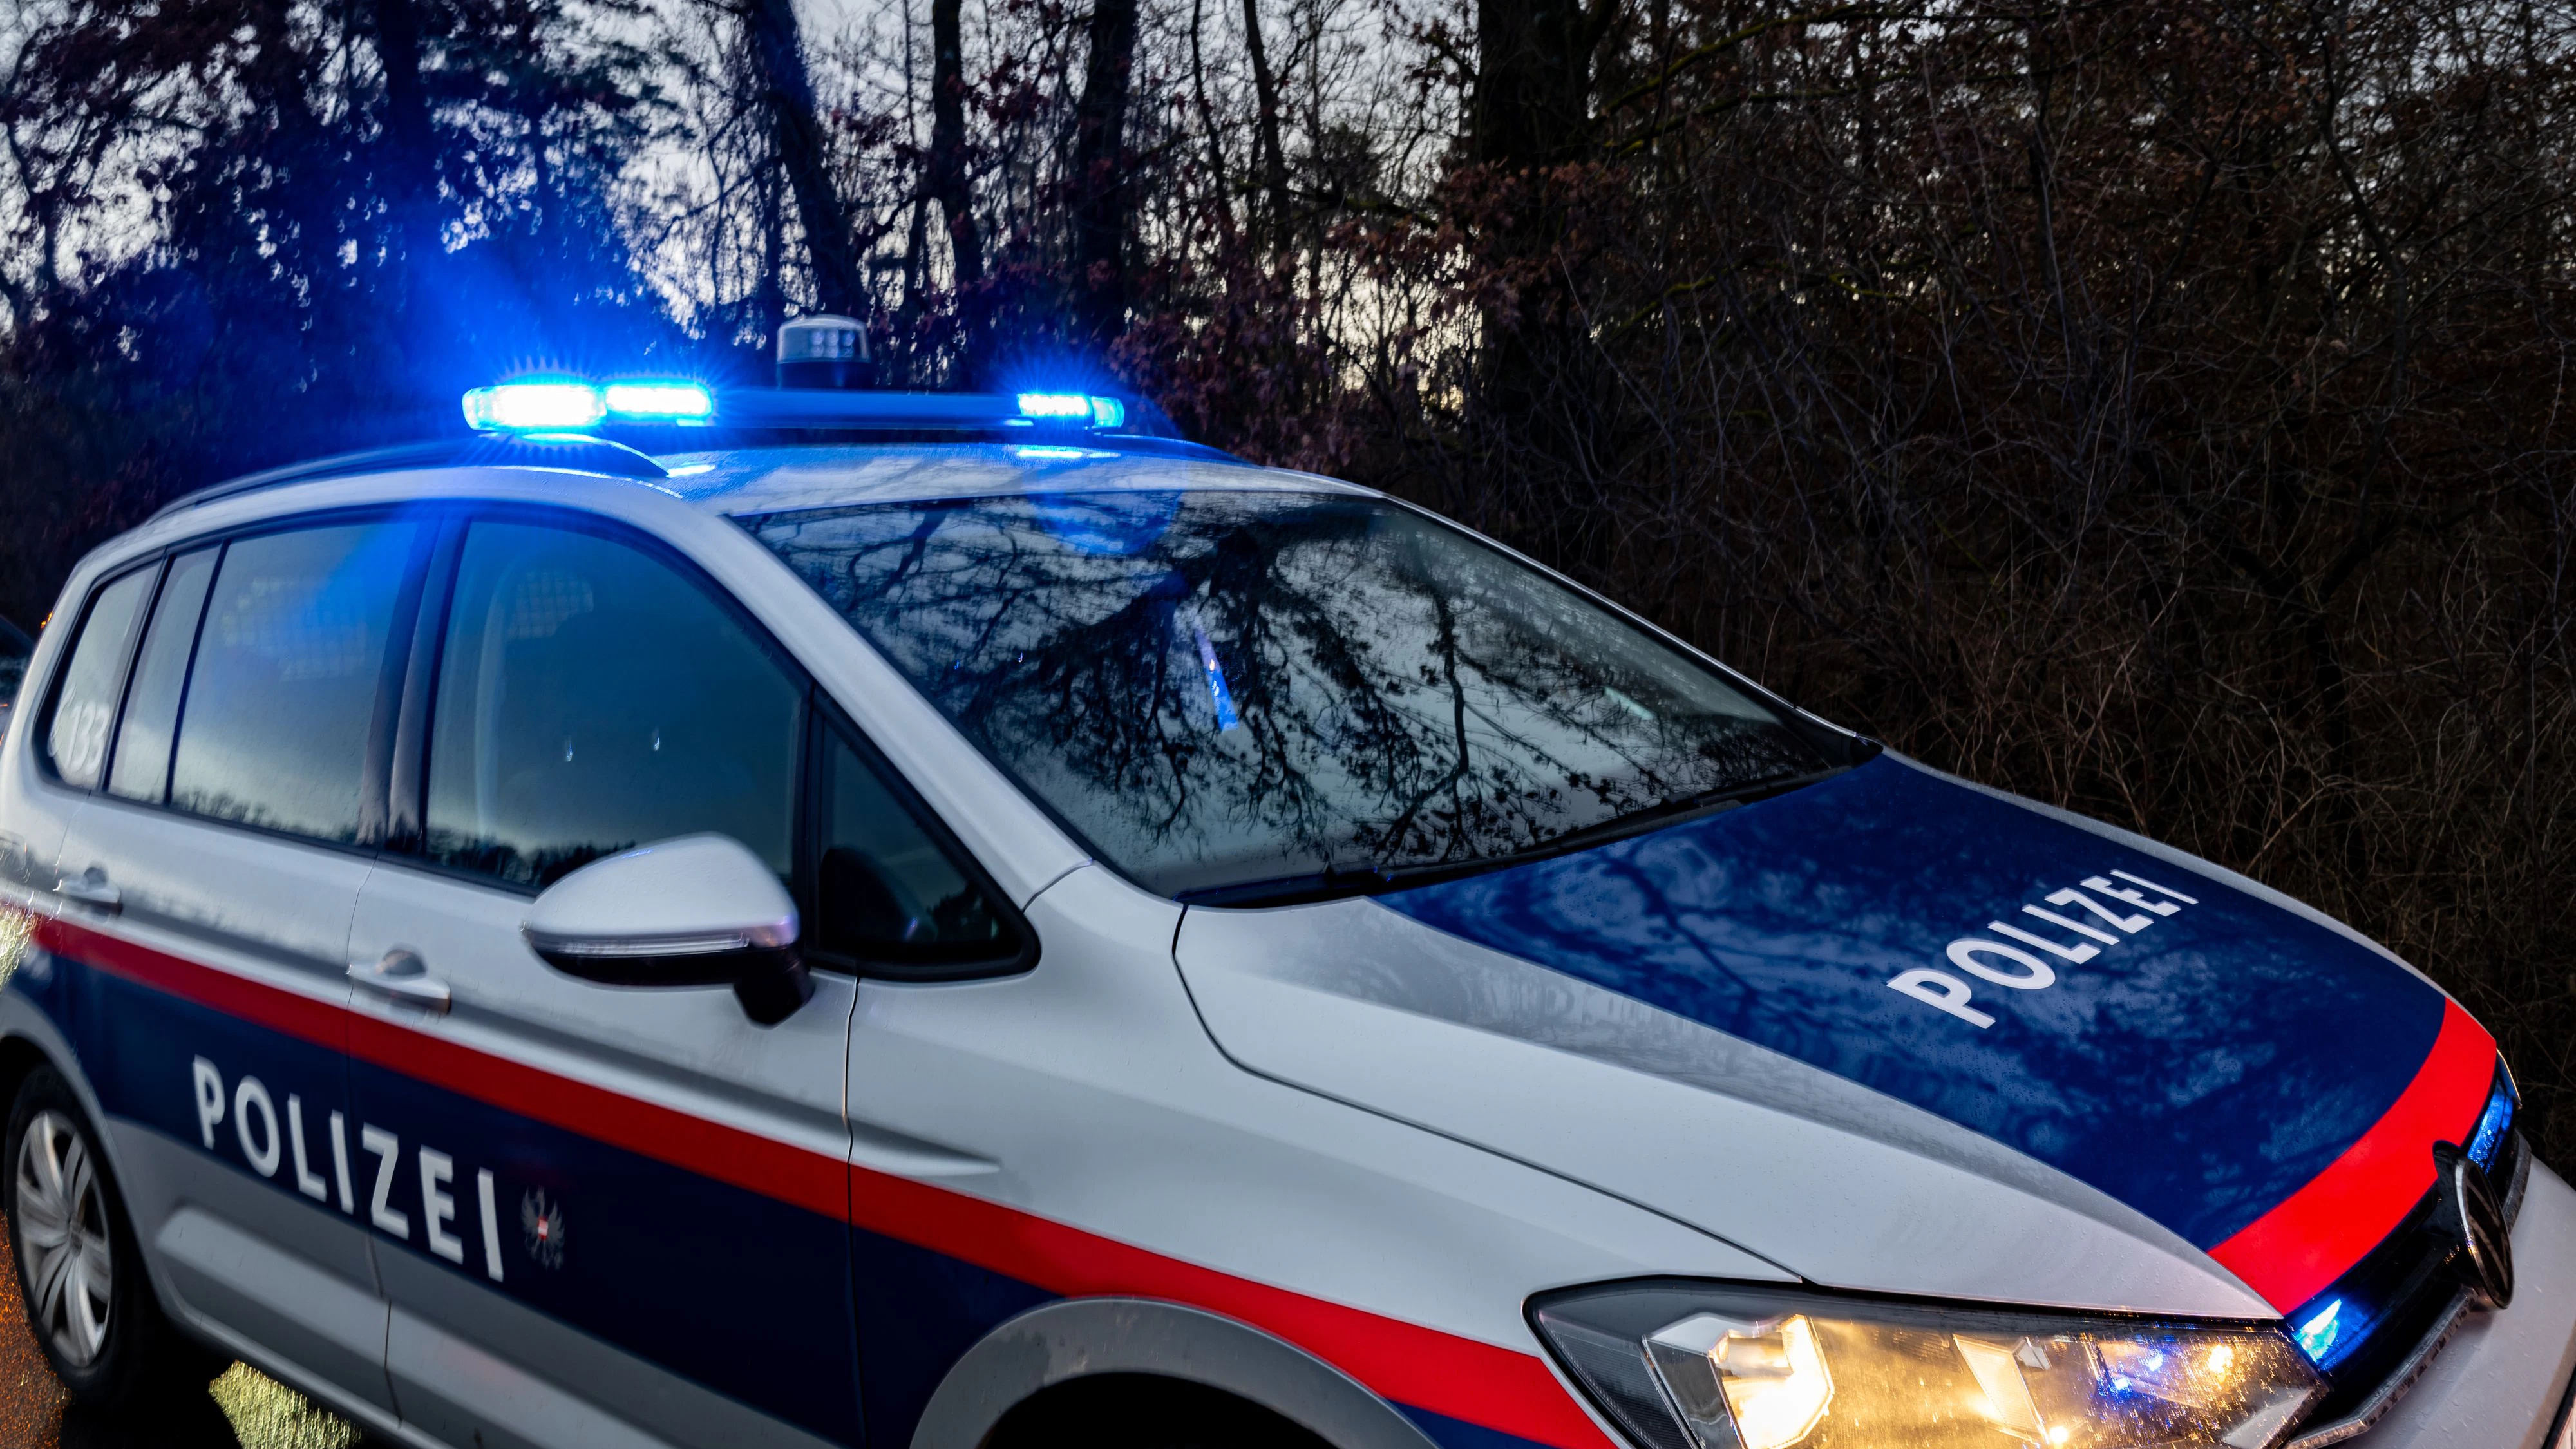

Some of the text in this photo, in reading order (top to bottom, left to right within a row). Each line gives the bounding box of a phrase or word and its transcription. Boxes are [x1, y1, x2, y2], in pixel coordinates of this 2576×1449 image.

[66, 700, 109, 775] 133
[1886, 869, 2199, 1029] POLIZEI
[193, 1054, 504, 1282] POLIZEI
